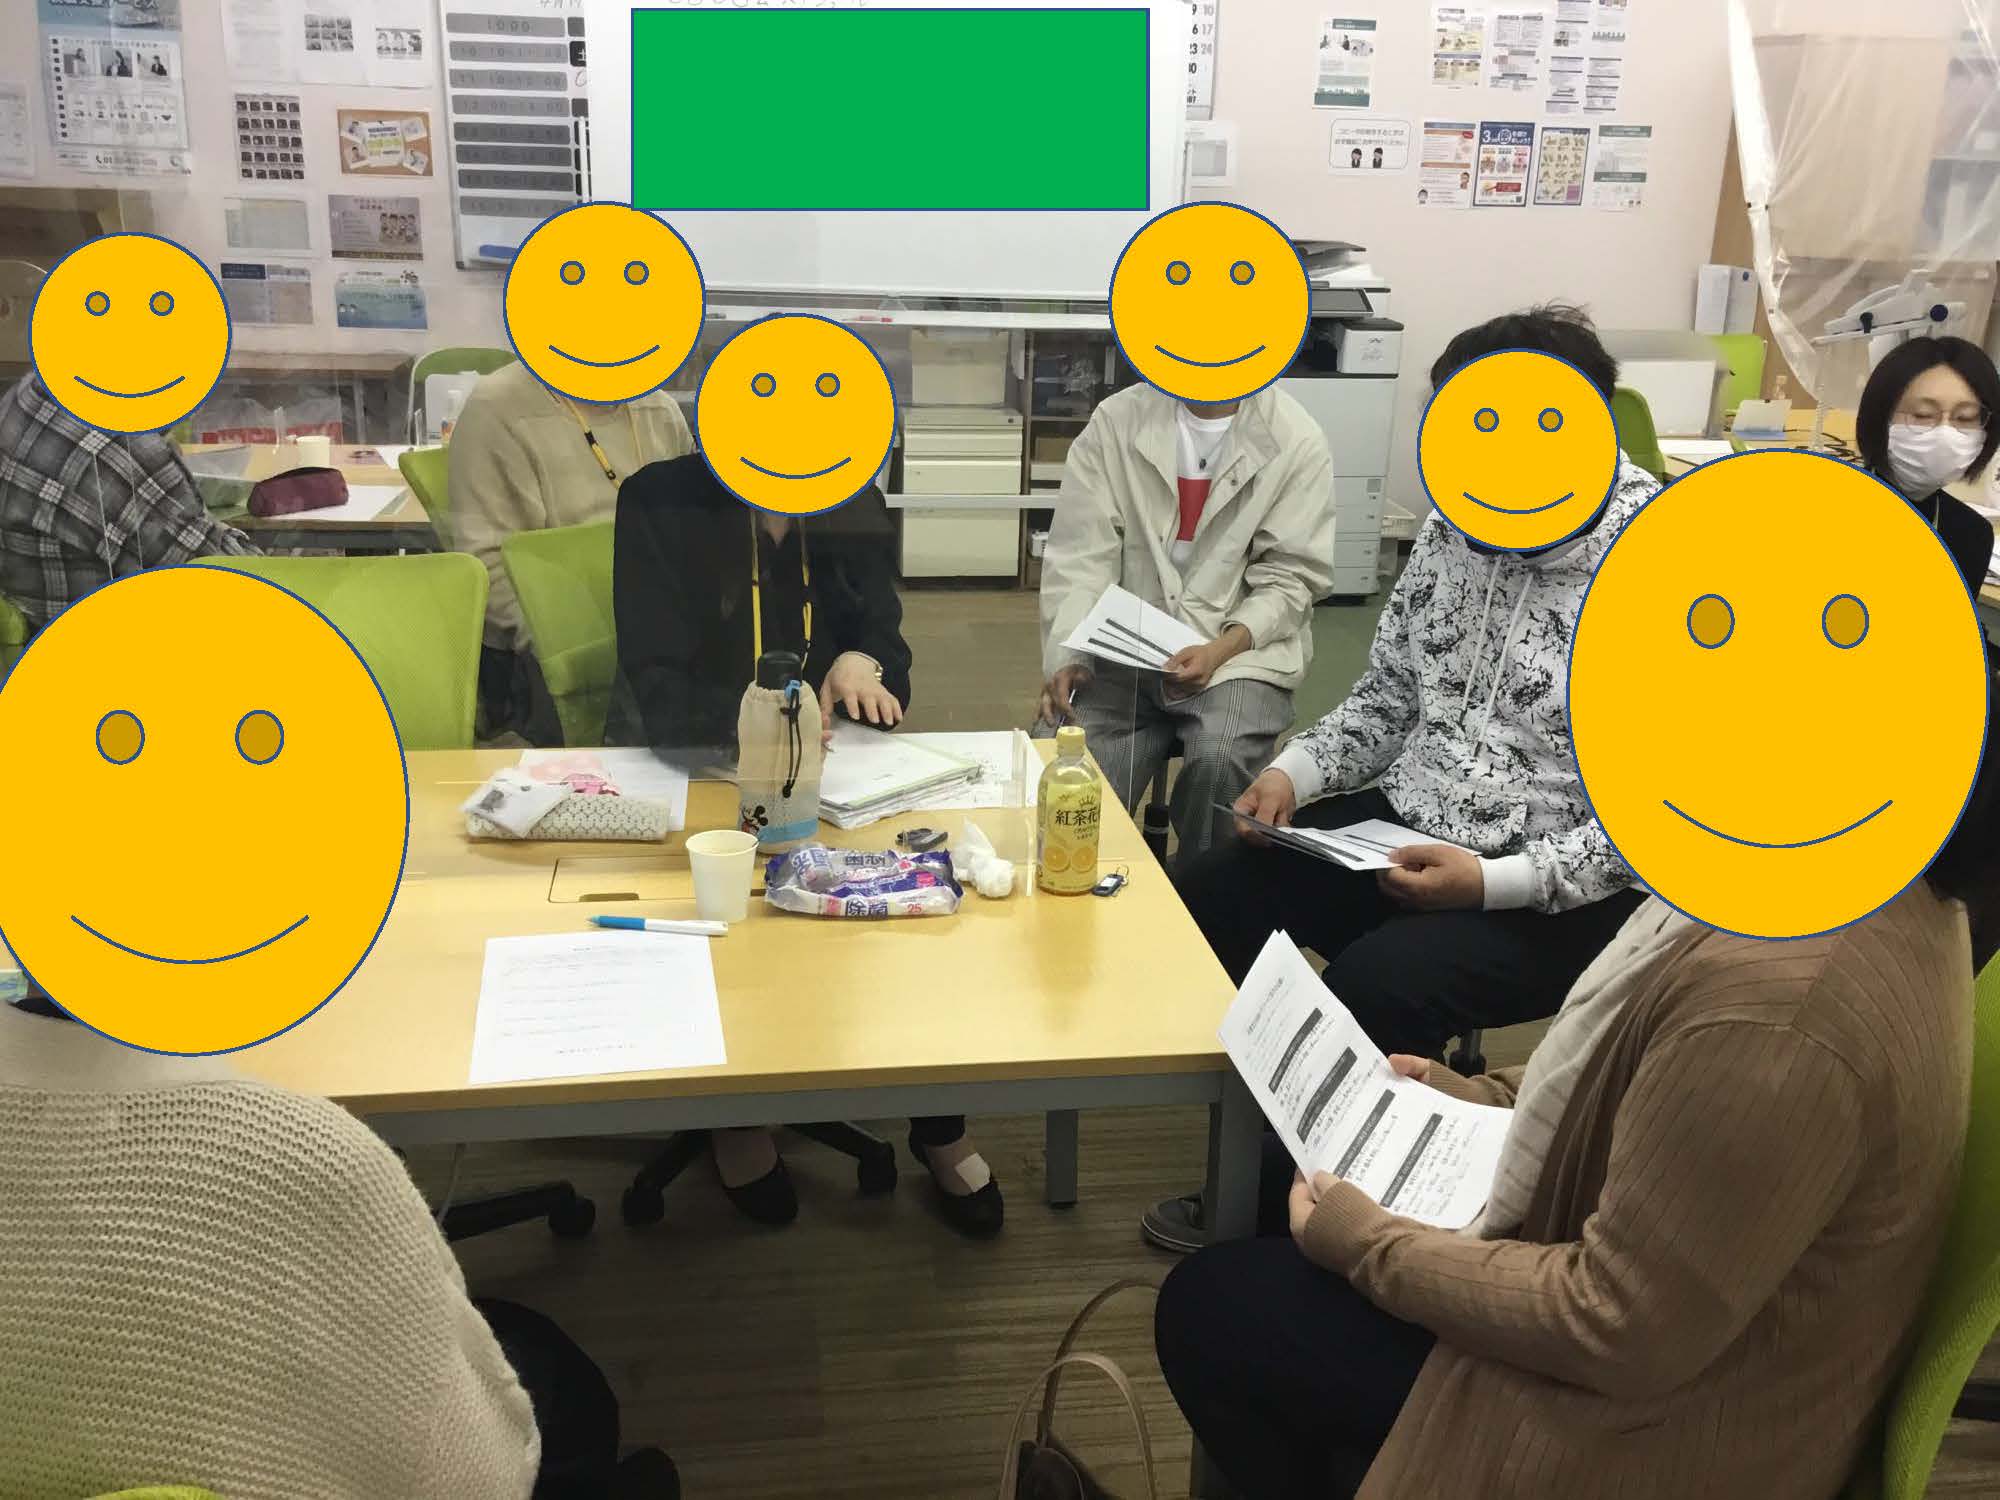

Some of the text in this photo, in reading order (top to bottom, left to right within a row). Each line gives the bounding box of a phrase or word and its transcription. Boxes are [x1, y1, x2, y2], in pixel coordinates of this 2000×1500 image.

[1203, 5, 1215, 16] 10
[1202, 24, 1214, 35] 17
[1201, 43, 1213, 55] 24
[1055, 806, 1098, 826] 紅茶花
[907, 904, 923, 914] 25
